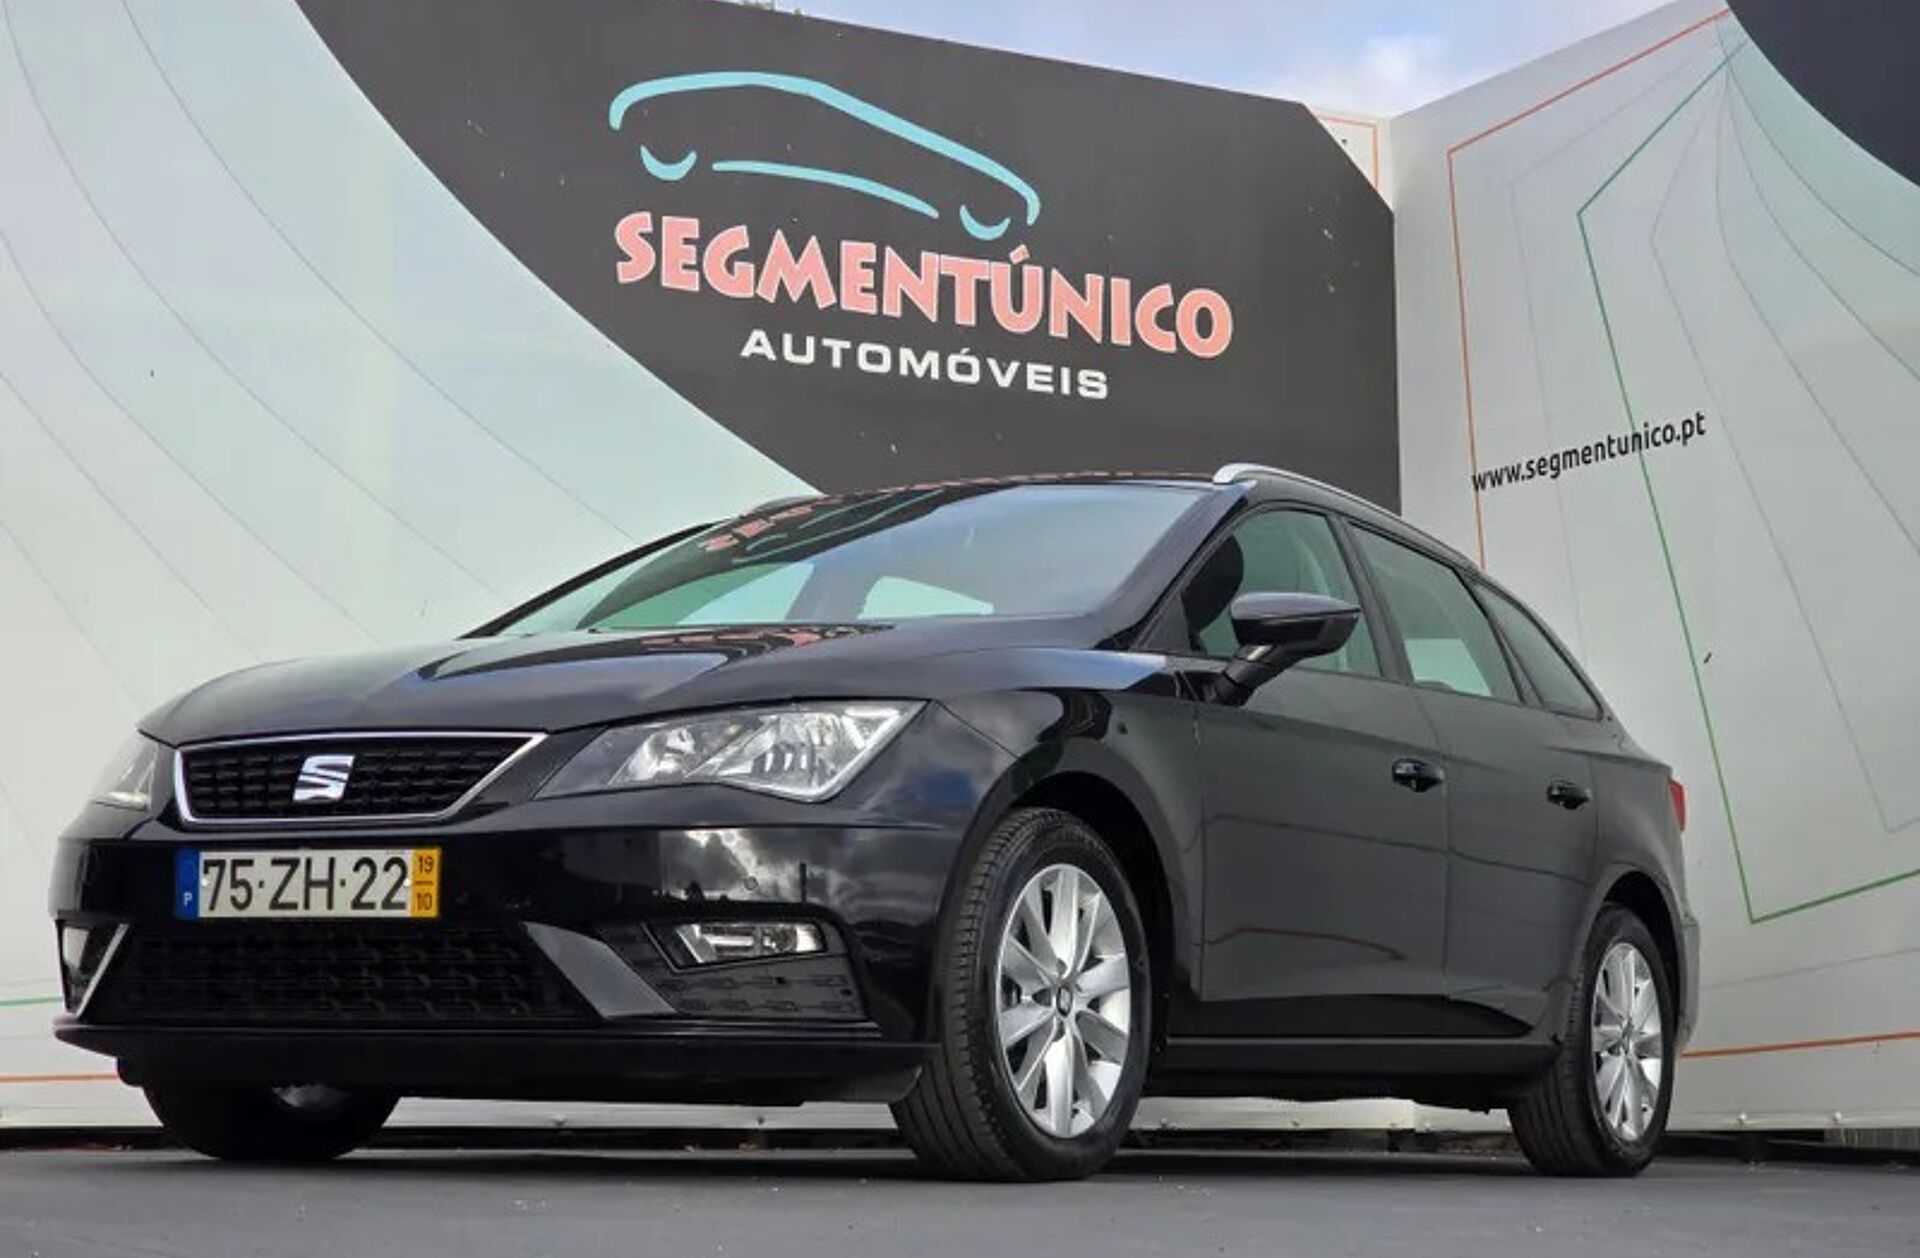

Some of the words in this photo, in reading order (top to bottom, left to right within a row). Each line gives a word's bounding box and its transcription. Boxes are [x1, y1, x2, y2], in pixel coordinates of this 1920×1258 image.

[614, 211, 1233, 358] SEGMENTÚNICO
[741, 328, 1109, 399] AUTOMÓVEIS
[1472, 411, 1706, 491] www.segmentunico.pt
[418, 855, 433, 873] 19
[417, 893, 433, 910] 10
